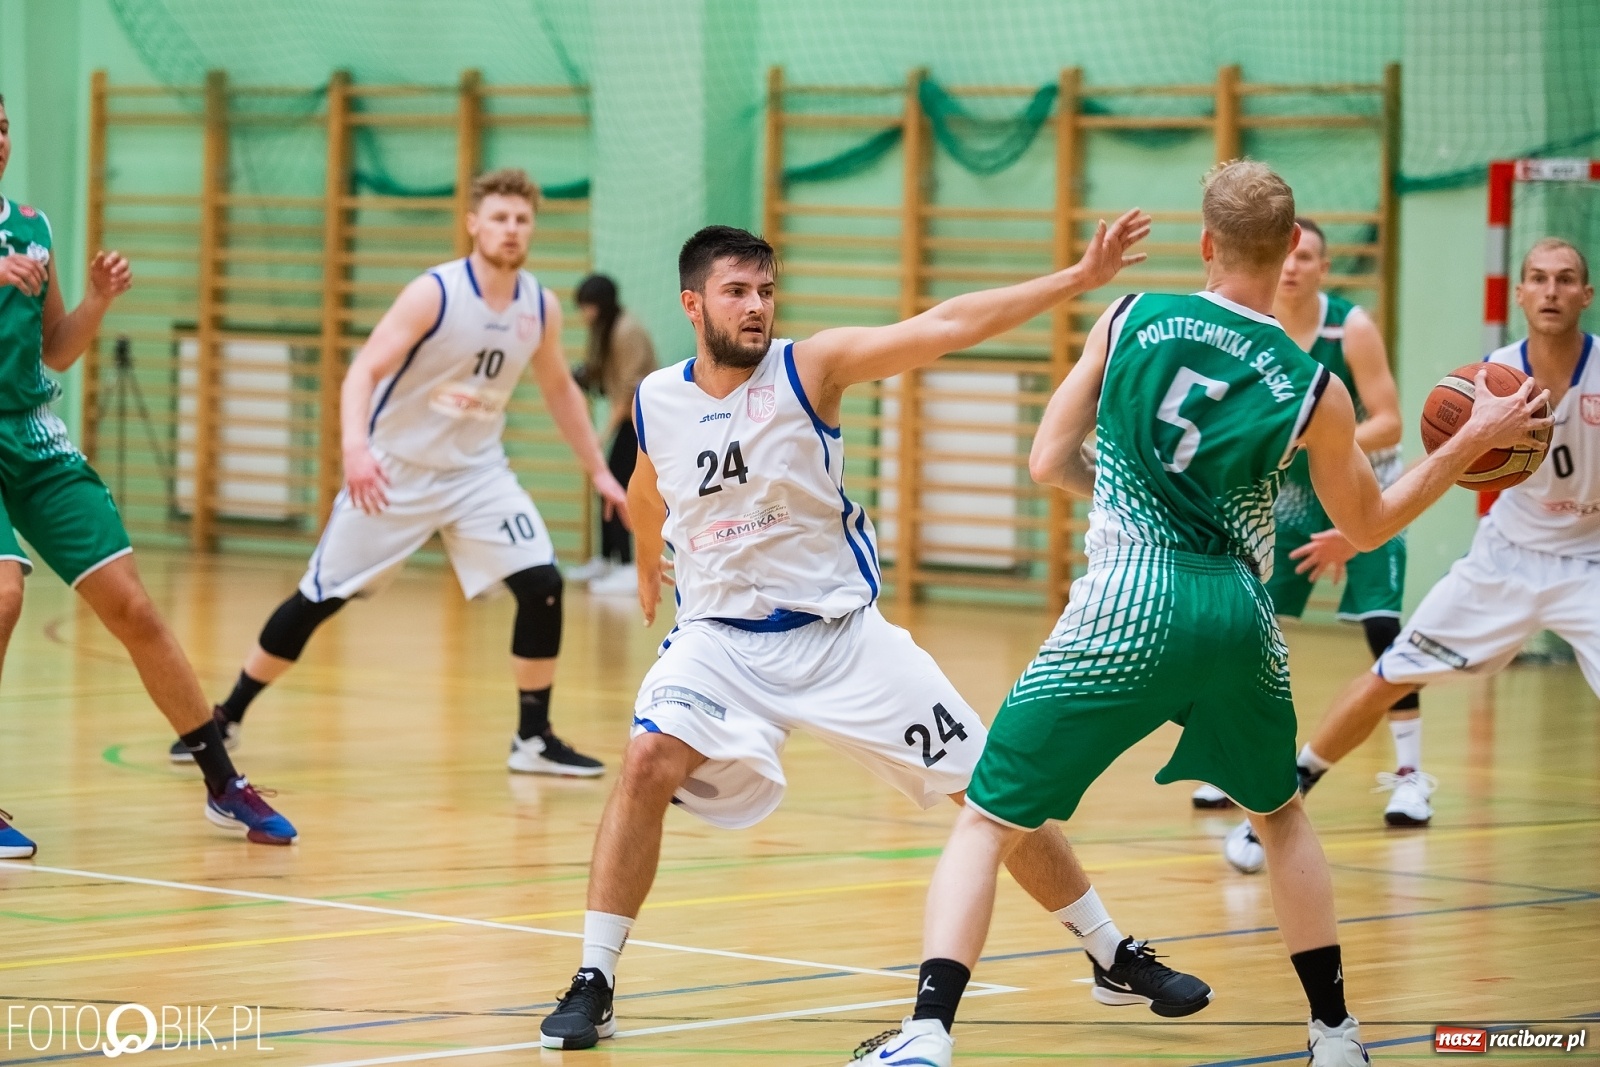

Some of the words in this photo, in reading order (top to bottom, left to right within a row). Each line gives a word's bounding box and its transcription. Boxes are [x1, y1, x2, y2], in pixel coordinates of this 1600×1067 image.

[472, 347, 506, 380] 10
[1136, 316, 1253, 362] POLITECHNIKA
[1249, 347, 1297, 404] ŚLĄSKA
[699, 412, 732, 424] stelmo
[1153, 365, 1231, 474] 5
[696, 440, 749, 498] 24
[499, 511, 536, 546] 10
[715, 513, 776, 540] KAMPKA
[904, 702, 969, 769] 24
